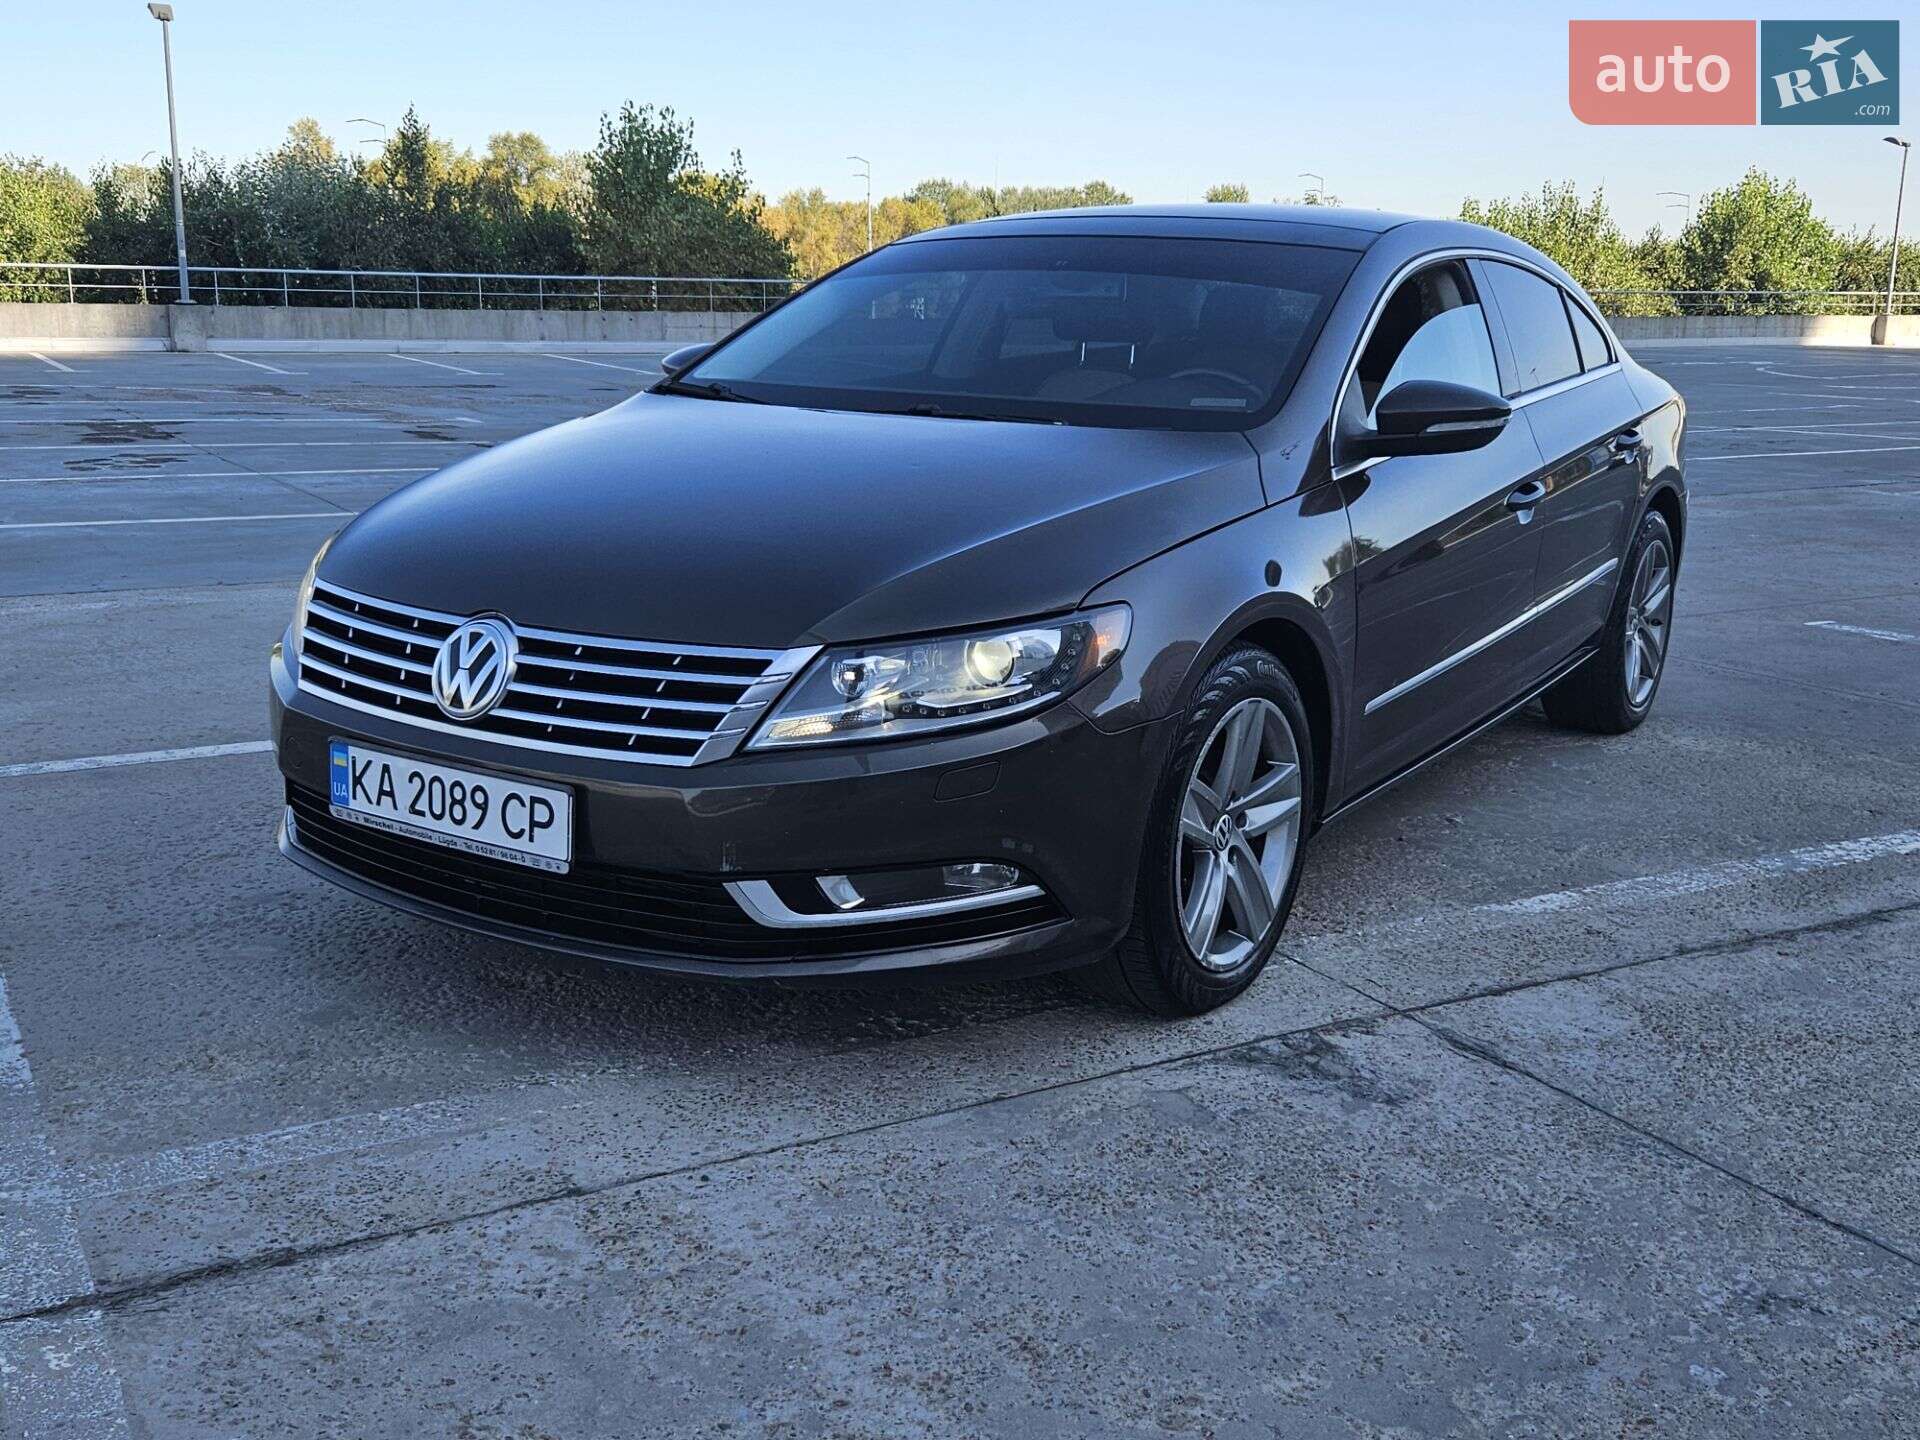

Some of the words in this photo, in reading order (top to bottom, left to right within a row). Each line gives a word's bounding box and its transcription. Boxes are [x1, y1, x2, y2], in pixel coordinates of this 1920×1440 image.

[435, 622, 506, 716] VW
[333, 782, 348, 798] UA
[351, 756, 398, 811] KA
[408, 770, 489, 830] 2089
[501, 792, 555, 842] CP
